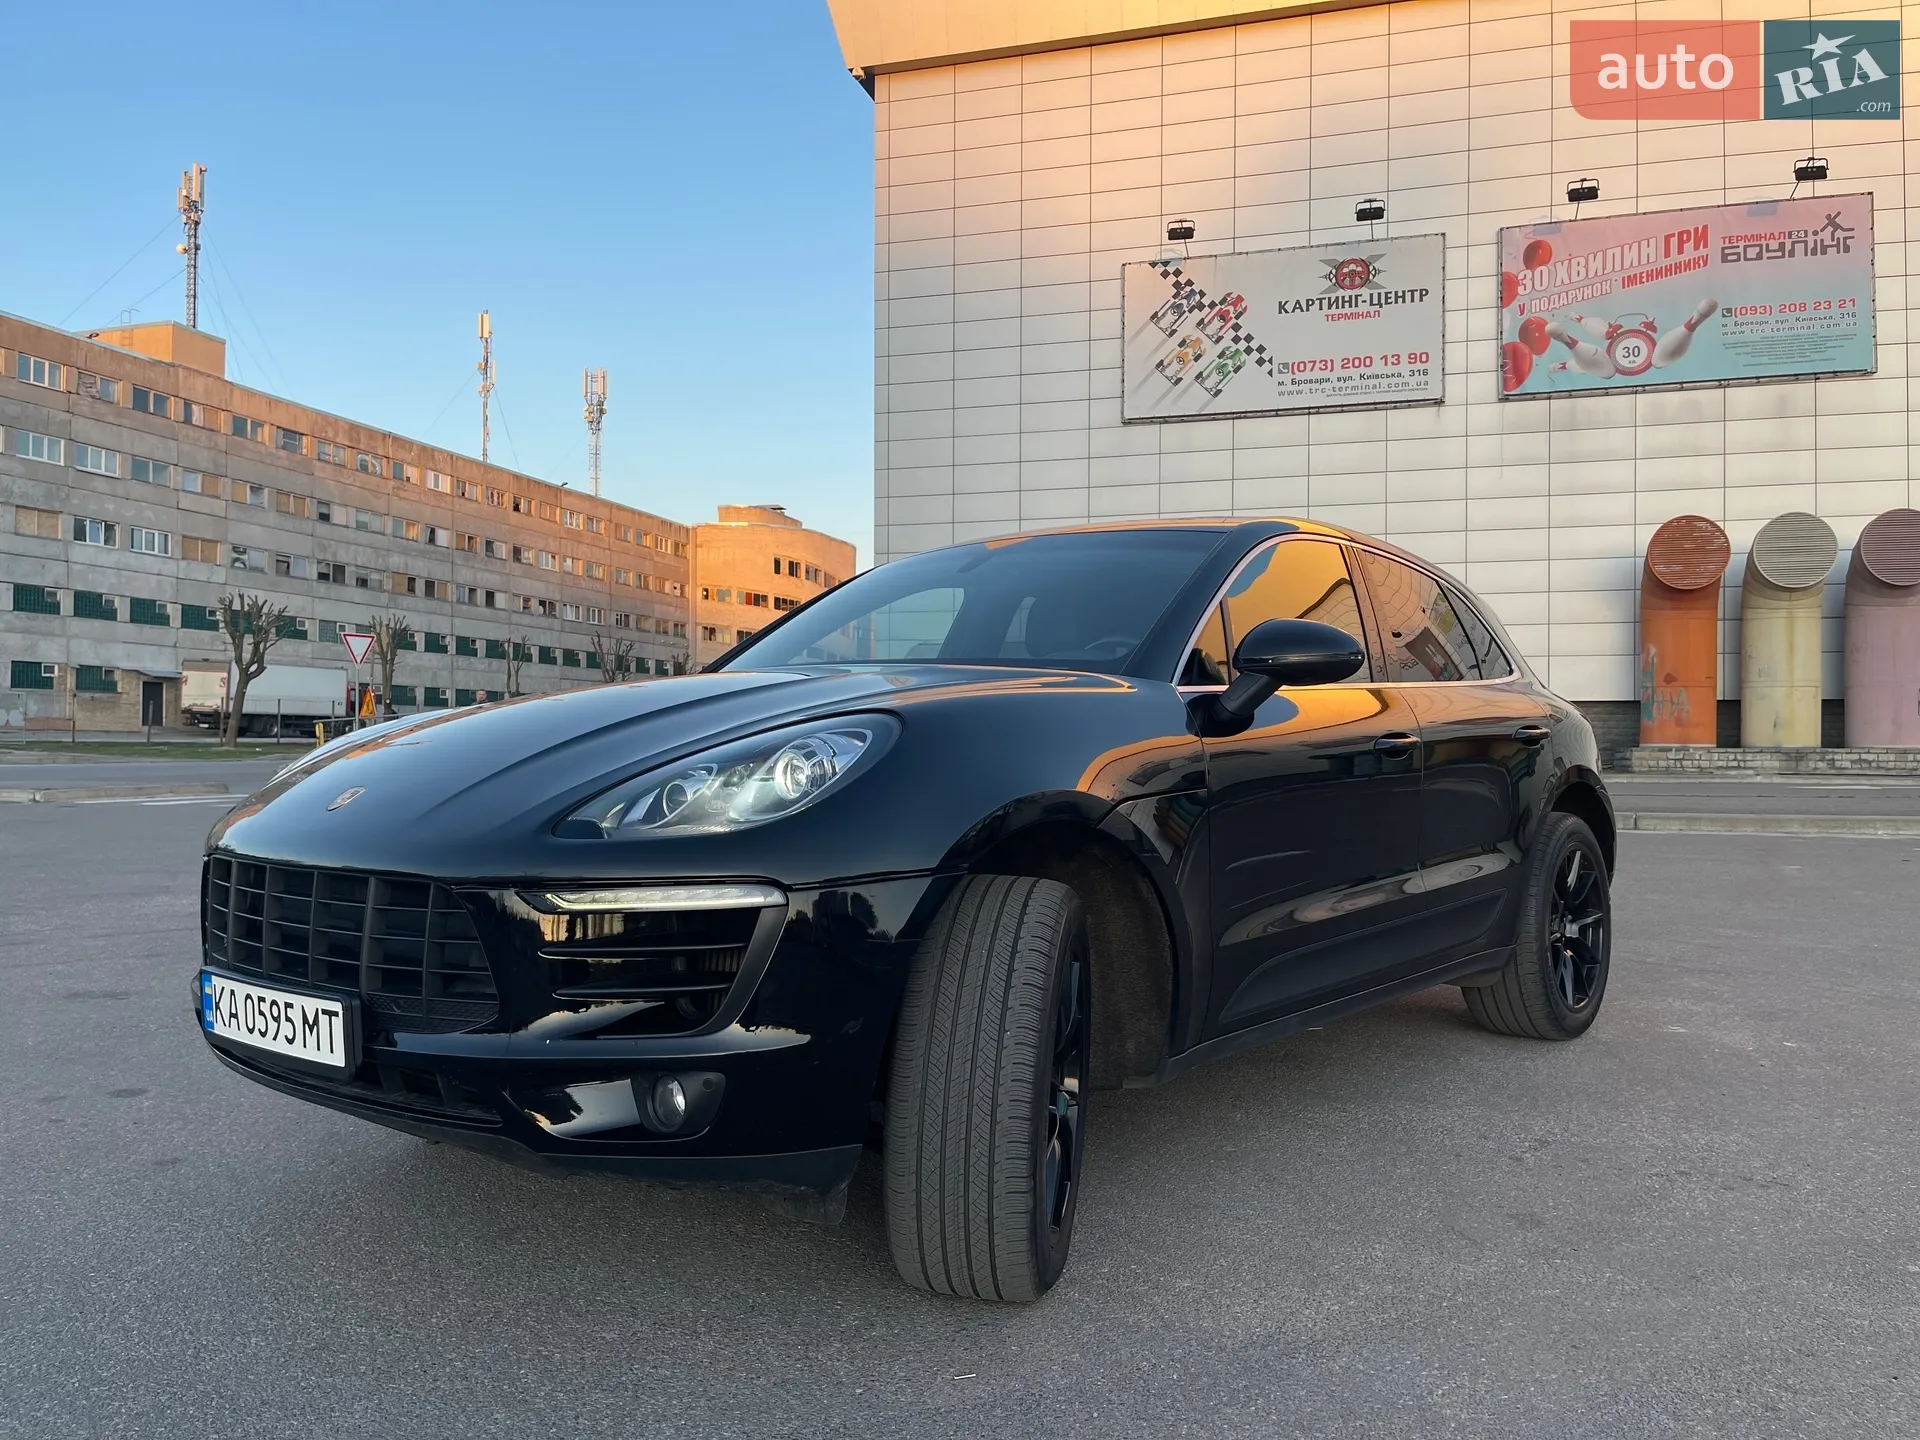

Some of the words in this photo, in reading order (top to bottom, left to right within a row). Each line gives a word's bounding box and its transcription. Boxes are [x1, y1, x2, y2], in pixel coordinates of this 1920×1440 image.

[1721, 231, 1787, 245] ТЕРМІНАЛ
[1791, 230, 1805, 239] 24
[1517, 265, 1550, 296] 30
[1553, 236, 1658, 288] ХВИЛИН
[1663, 224, 1709, 260] ГРИ
[1518, 303, 1526, 316] У
[1531, 279, 1612, 314] ПОДАРУНОК
[1621, 253, 1709, 290] ІМЕНИННИКУ
[1277, 288, 1430, 315] КАРТИНГ-ЦЕНТР
[1733, 305, 1773, 318] (093)
[1778, 302, 1807, 314] 208
[1813, 300, 1832, 311] 23
[1838, 298, 1856, 309] 21
[1324, 309, 1381, 322] ТЕРМІНАЛ
[1839, 311, 1857, 319] 316
[1622, 345, 1641, 358] 30
[1291, 358, 1335, 375] (073)
[1340, 355, 1373, 370] 200
[1380, 353, 1401, 367] 13
[1407, 351, 1430, 365] 90
[1291, 376, 1333, 387] Бровари,
[1336, 375, 1356, 384] вул.
[1408, 368, 1429, 377] 316
[1277, 379, 1429, 397] www.trc-terminal.com.ua
[244, 993, 297, 1045] 0595
